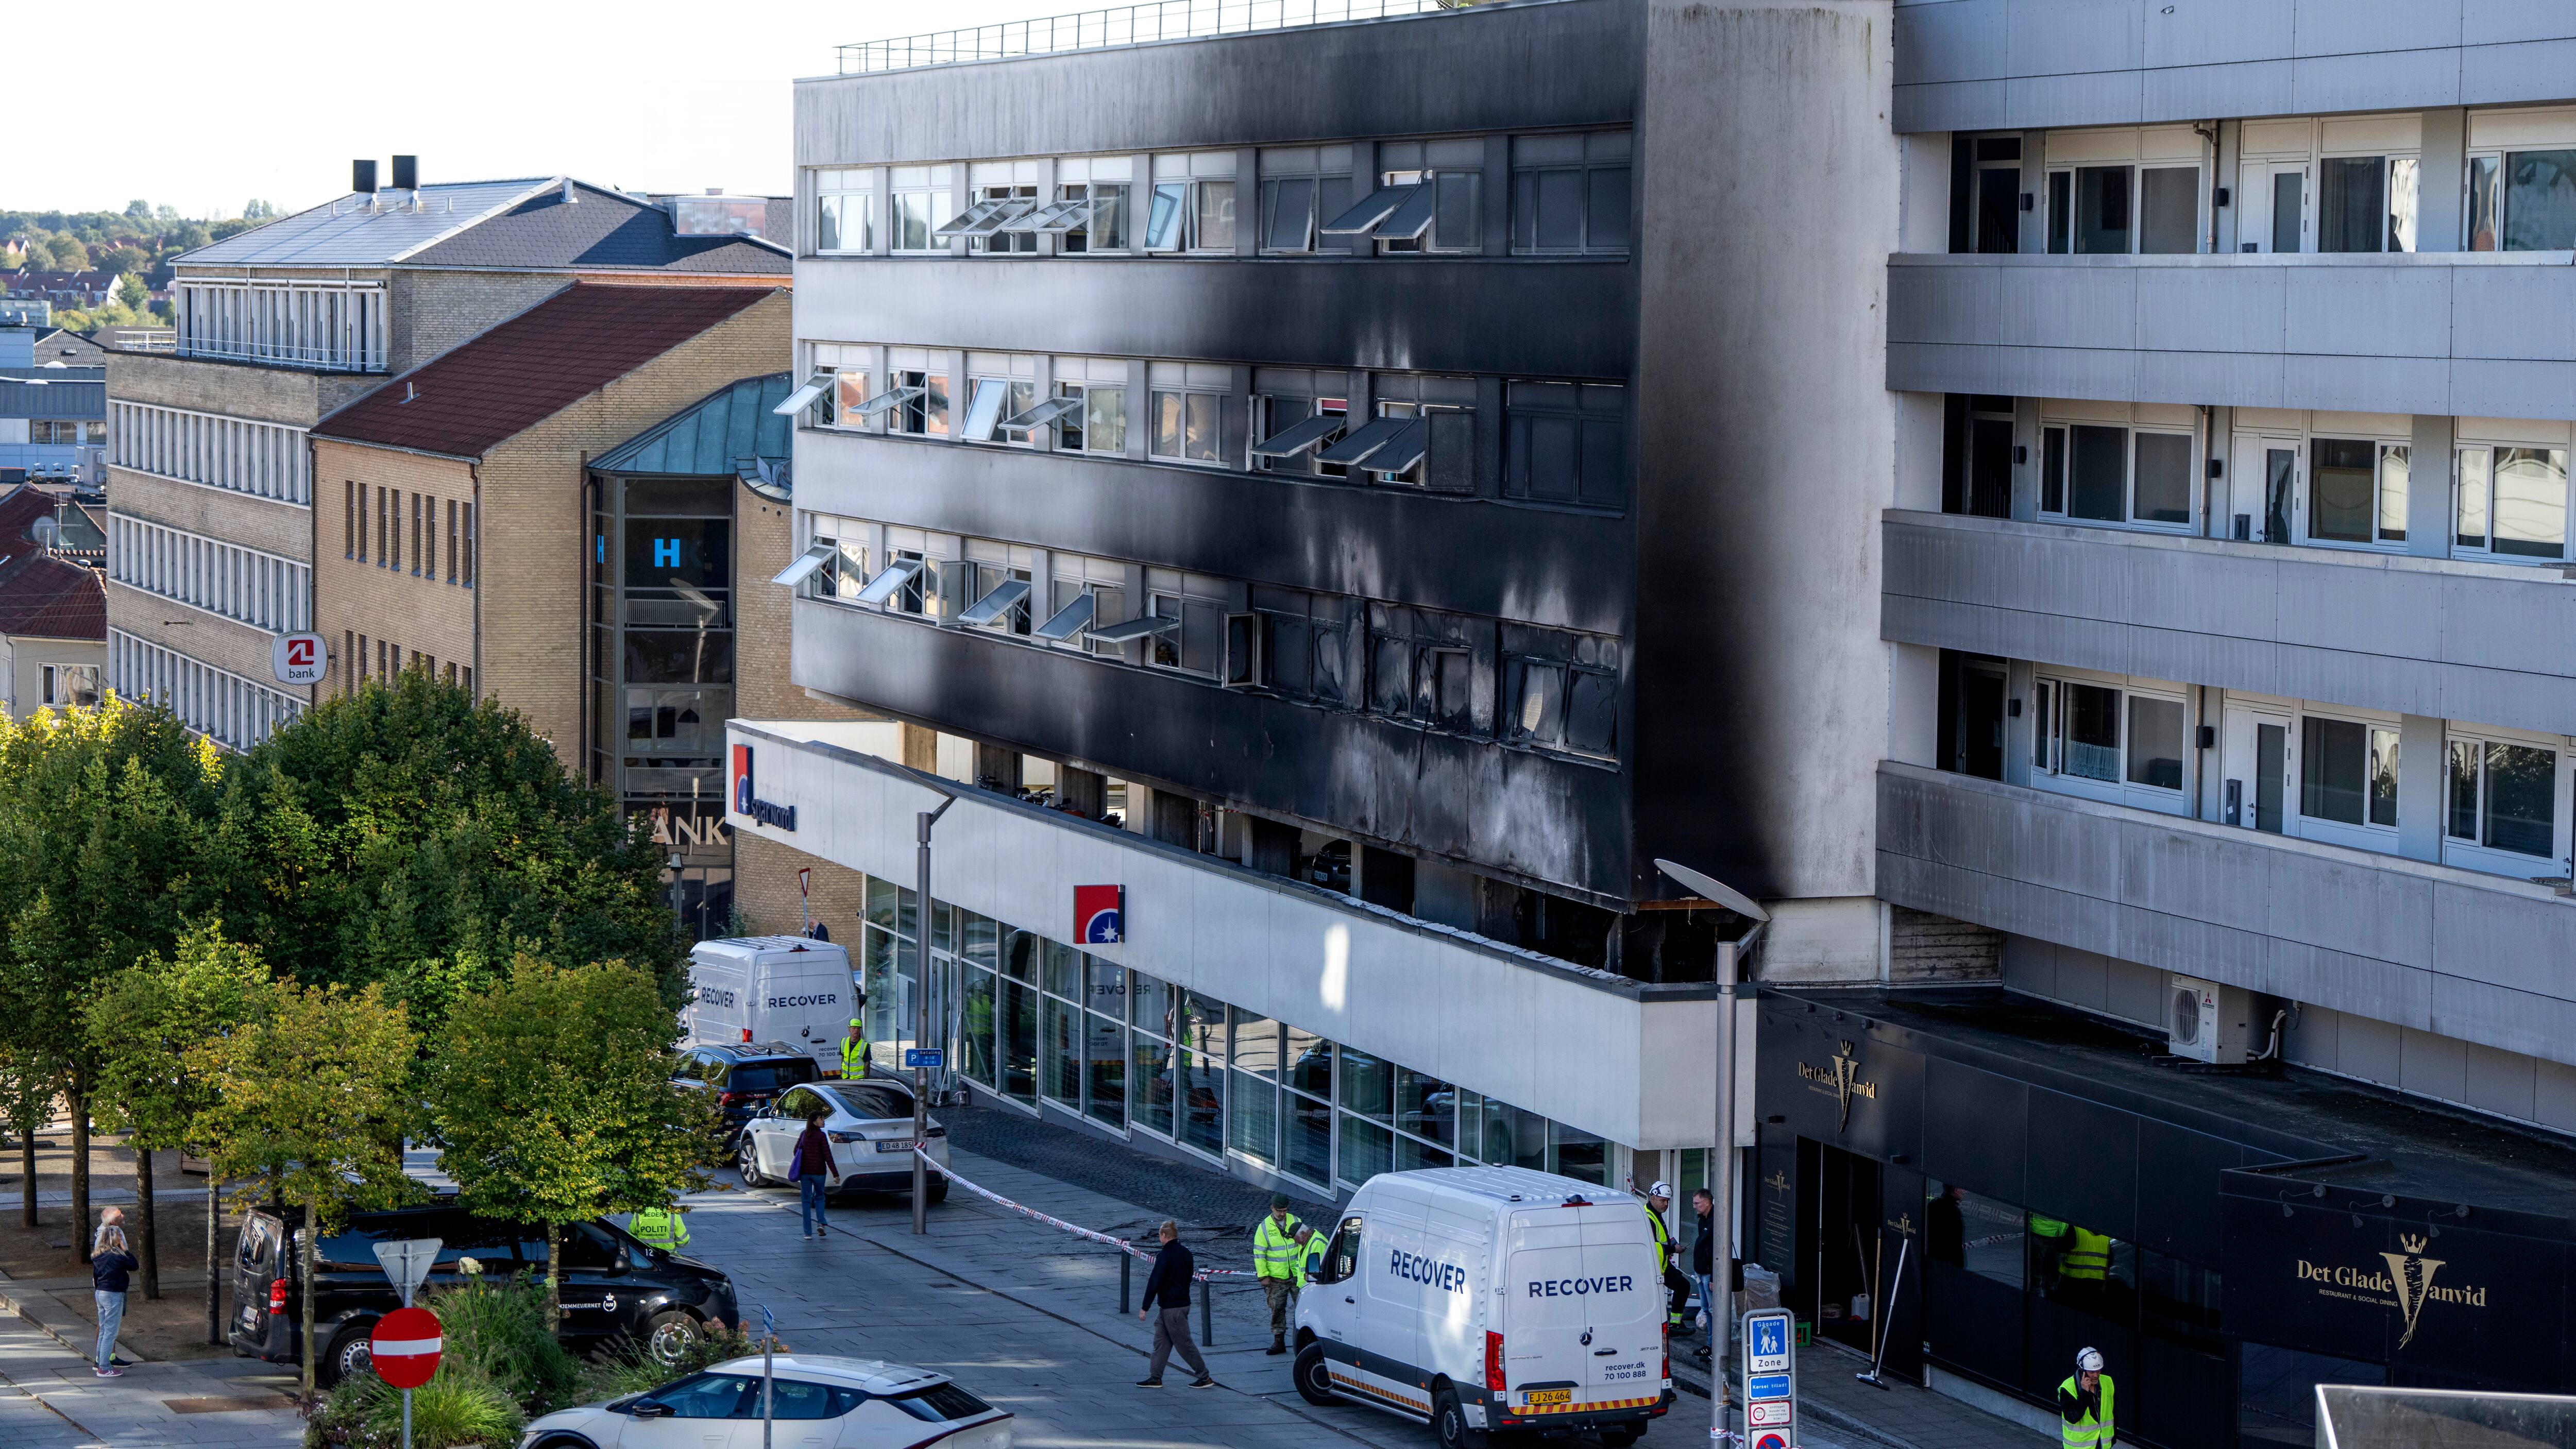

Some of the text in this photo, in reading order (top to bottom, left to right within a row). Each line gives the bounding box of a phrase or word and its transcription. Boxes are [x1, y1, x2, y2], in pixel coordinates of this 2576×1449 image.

[289, 668, 315, 678] bank
[701, 986, 734, 1009] RECOVER
[768, 994, 836, 1008] RECOVER
[1798, 1061, 1813, 1080] Det
[1814, 1066, 1838, 1087] Glade
[645, 1248, 654, 1256] 12
[1391, 1249, 1465, 1294] RECOVER
[2297, 1259, 2331, 1283] Det
[2334, 1266, 2393, 1293] Glade
[1528, 1275, 1633, 1298] RECOVER
[2318, 1288, 2352, 1300] RESTAURANT
[2358, 1295, 2378, 1304] SOCIAL
[2379, 1299, 2398, 1307] DINING
[1605, 1361, 1646, 1371] recover.dk
[1530, 1391, 1570, 1403] EJ 26 464
